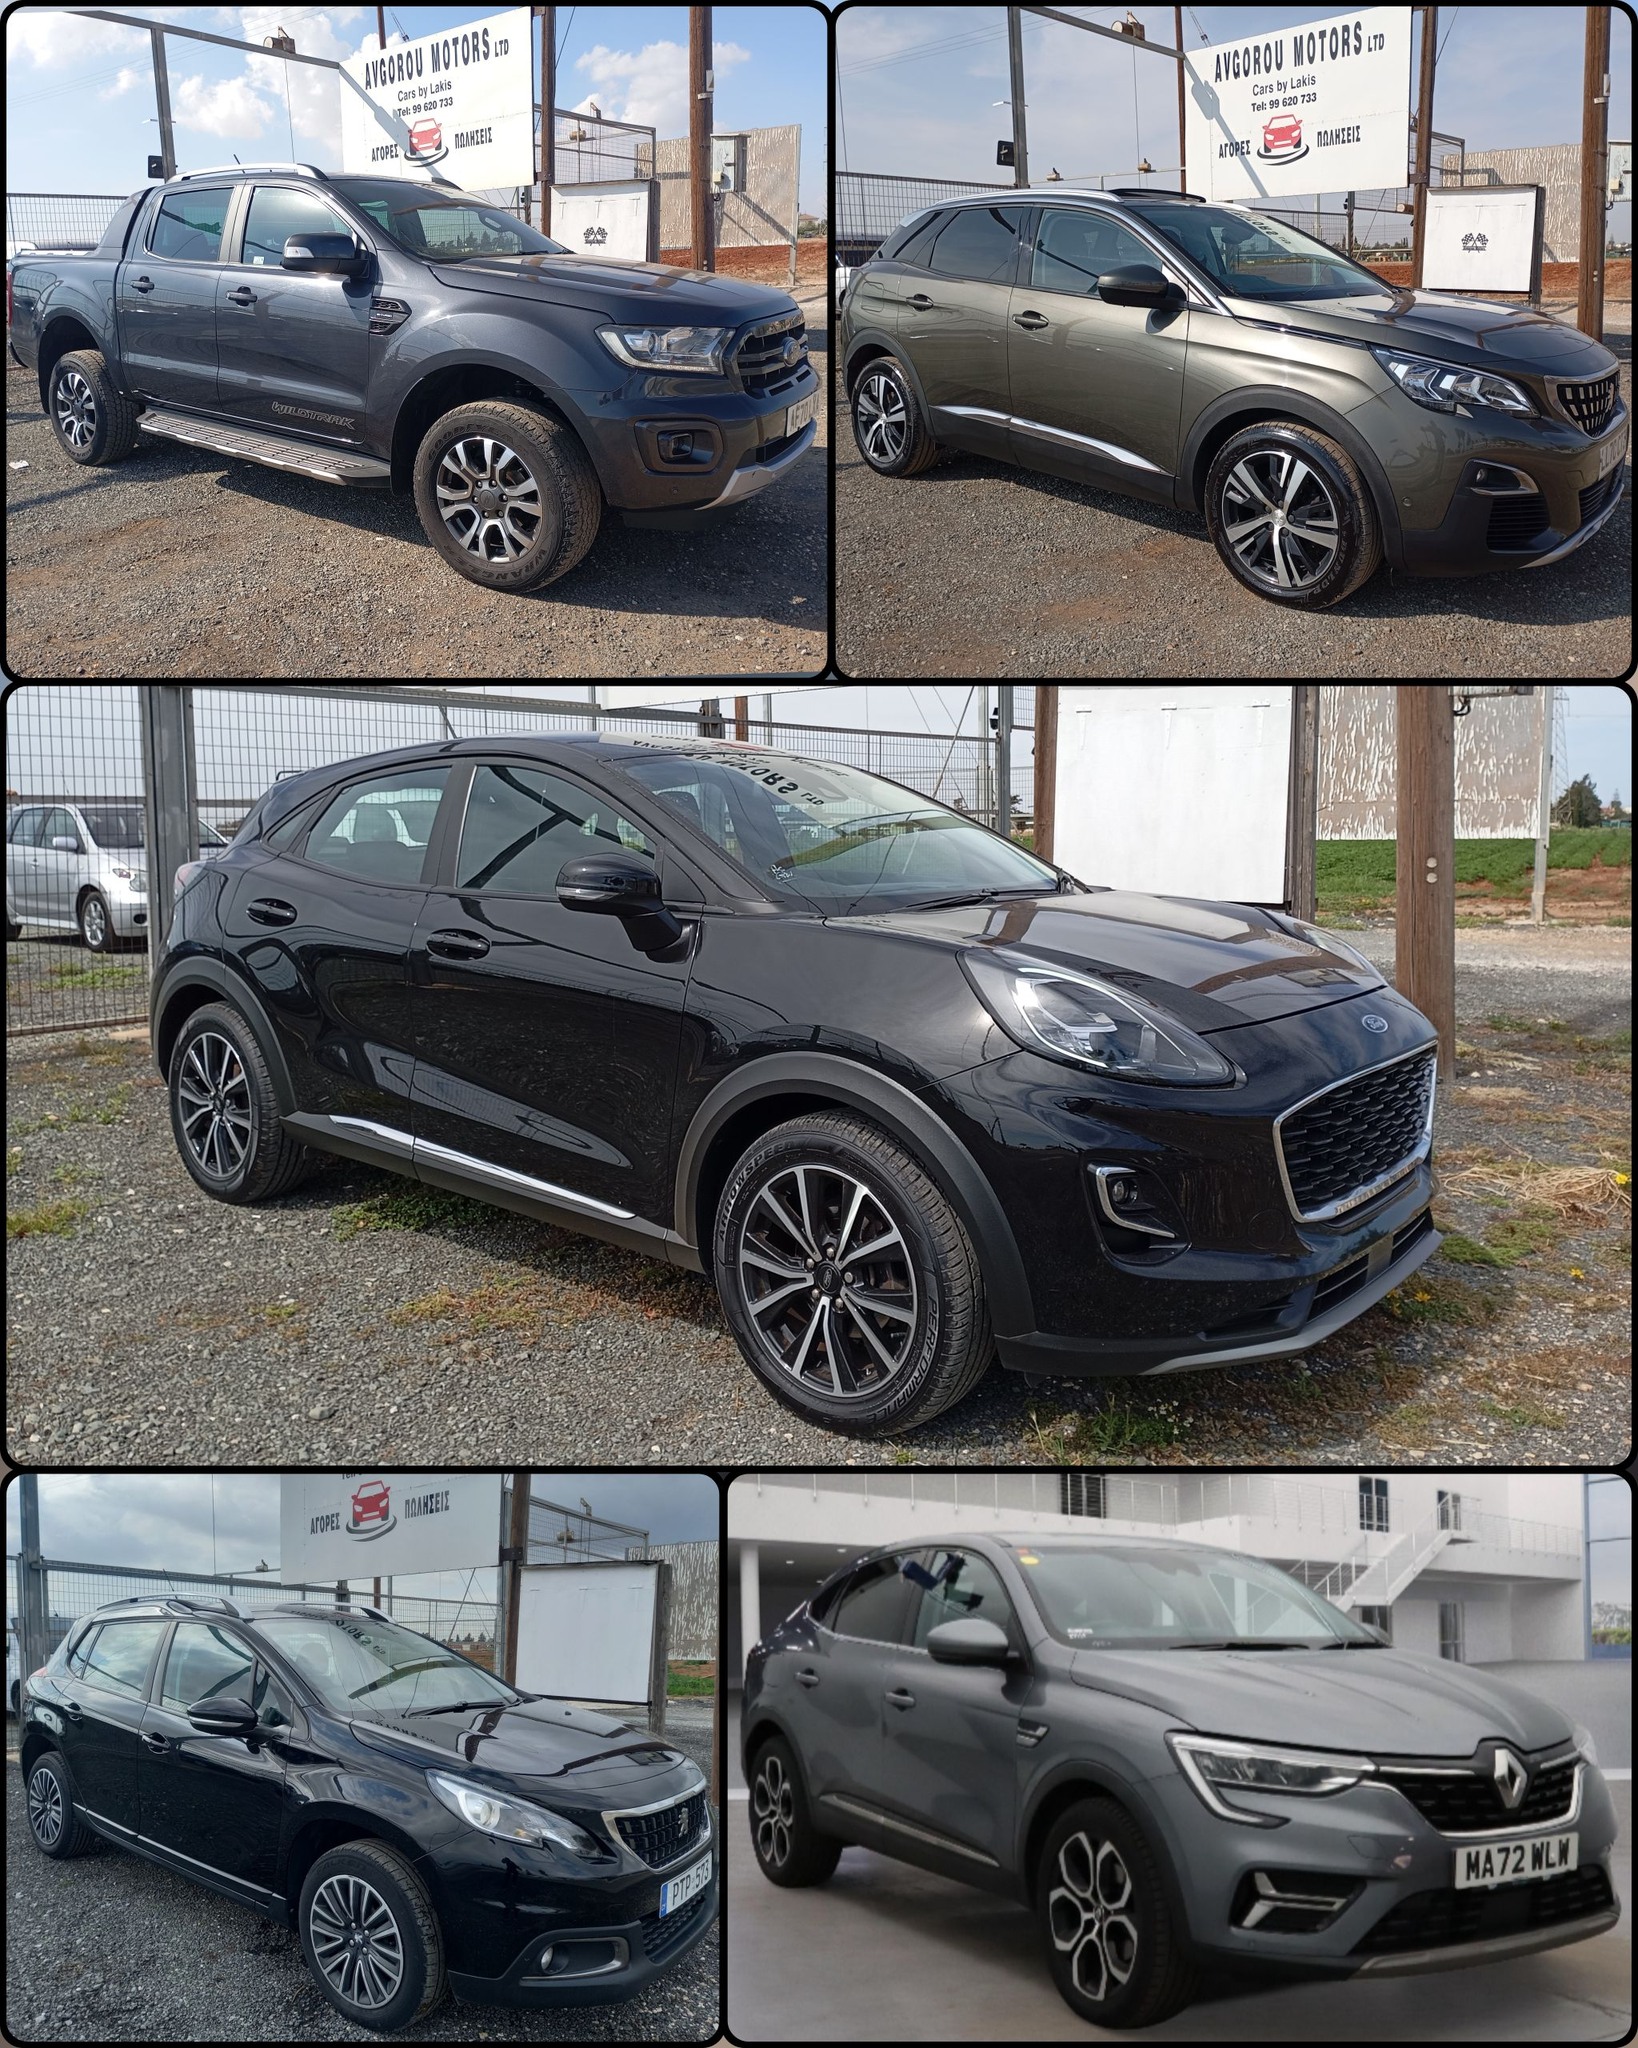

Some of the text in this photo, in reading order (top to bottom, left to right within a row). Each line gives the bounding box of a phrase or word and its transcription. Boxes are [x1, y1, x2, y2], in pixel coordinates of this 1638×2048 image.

[365, 27, 509, 90] AVGOROU MOTORS LTD
[1214, 21, 1385, 83] AVGOROU MOTORS LTD
[397, 79, 452, 102] Cars by Lakis
[1252, 74, 1316, 97] Cars by Lakis
[397, 96, 453, 117] Tel: 99 620 733
[1251, 92, 1317, 112] Tel: 99 620 733
[454, 127, 493, 149] ΠΩΛΗΣΕΙΣ
[1317, 125, 1361, 148] ΠΩΛΗΣΕΙΣ
[371, 144, 399, 162] ΑΓΟΡΕΣ
[1218, 140, 1251, 159] ΑΓΟΡΕΣ
[271, 401, 356, 430] WILDTRAK
[867, 1296, 938, 1420] PERFORMANCE
[404, 1490, 450, 1519] ΠΩΛΗΣΕΙΣ
[310, 1512, 340, 1535] ΑΓΟΡΕΣ
[1466, 1838, 1570, 1881] MA72 WLW
[672, 1859, 709, 1906] PTP 573
